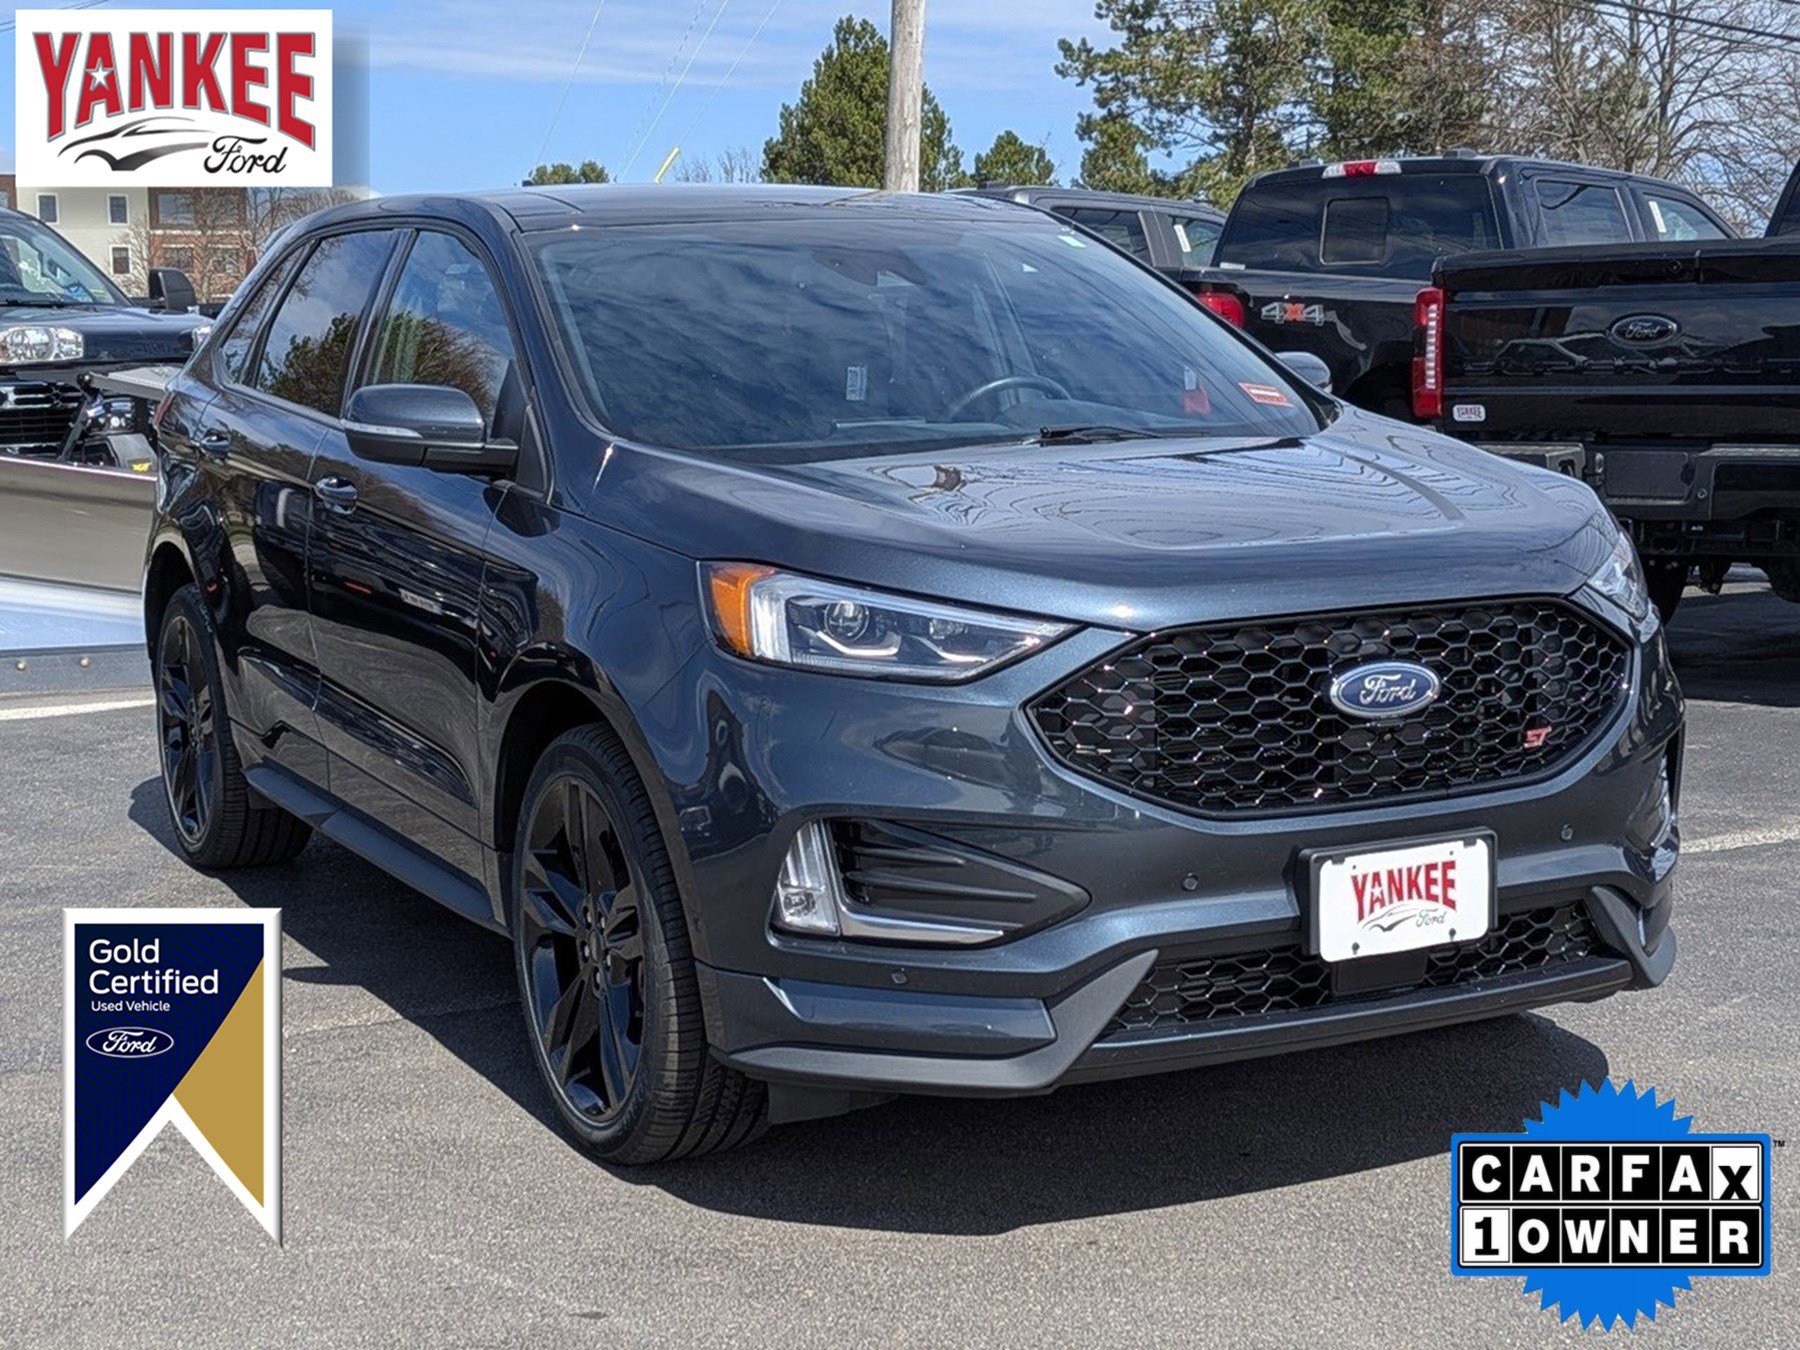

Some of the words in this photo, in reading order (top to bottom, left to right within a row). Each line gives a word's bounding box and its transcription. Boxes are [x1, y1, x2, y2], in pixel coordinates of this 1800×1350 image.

[1626, 322, 1661, 339] Ford
[1359, 673, 1417, 705] Ford
[1523, 725, 1552, 749] ST
[1350, 859, 1457, 924] YANKEE
[1416, 908, 1448, 928] Ford
